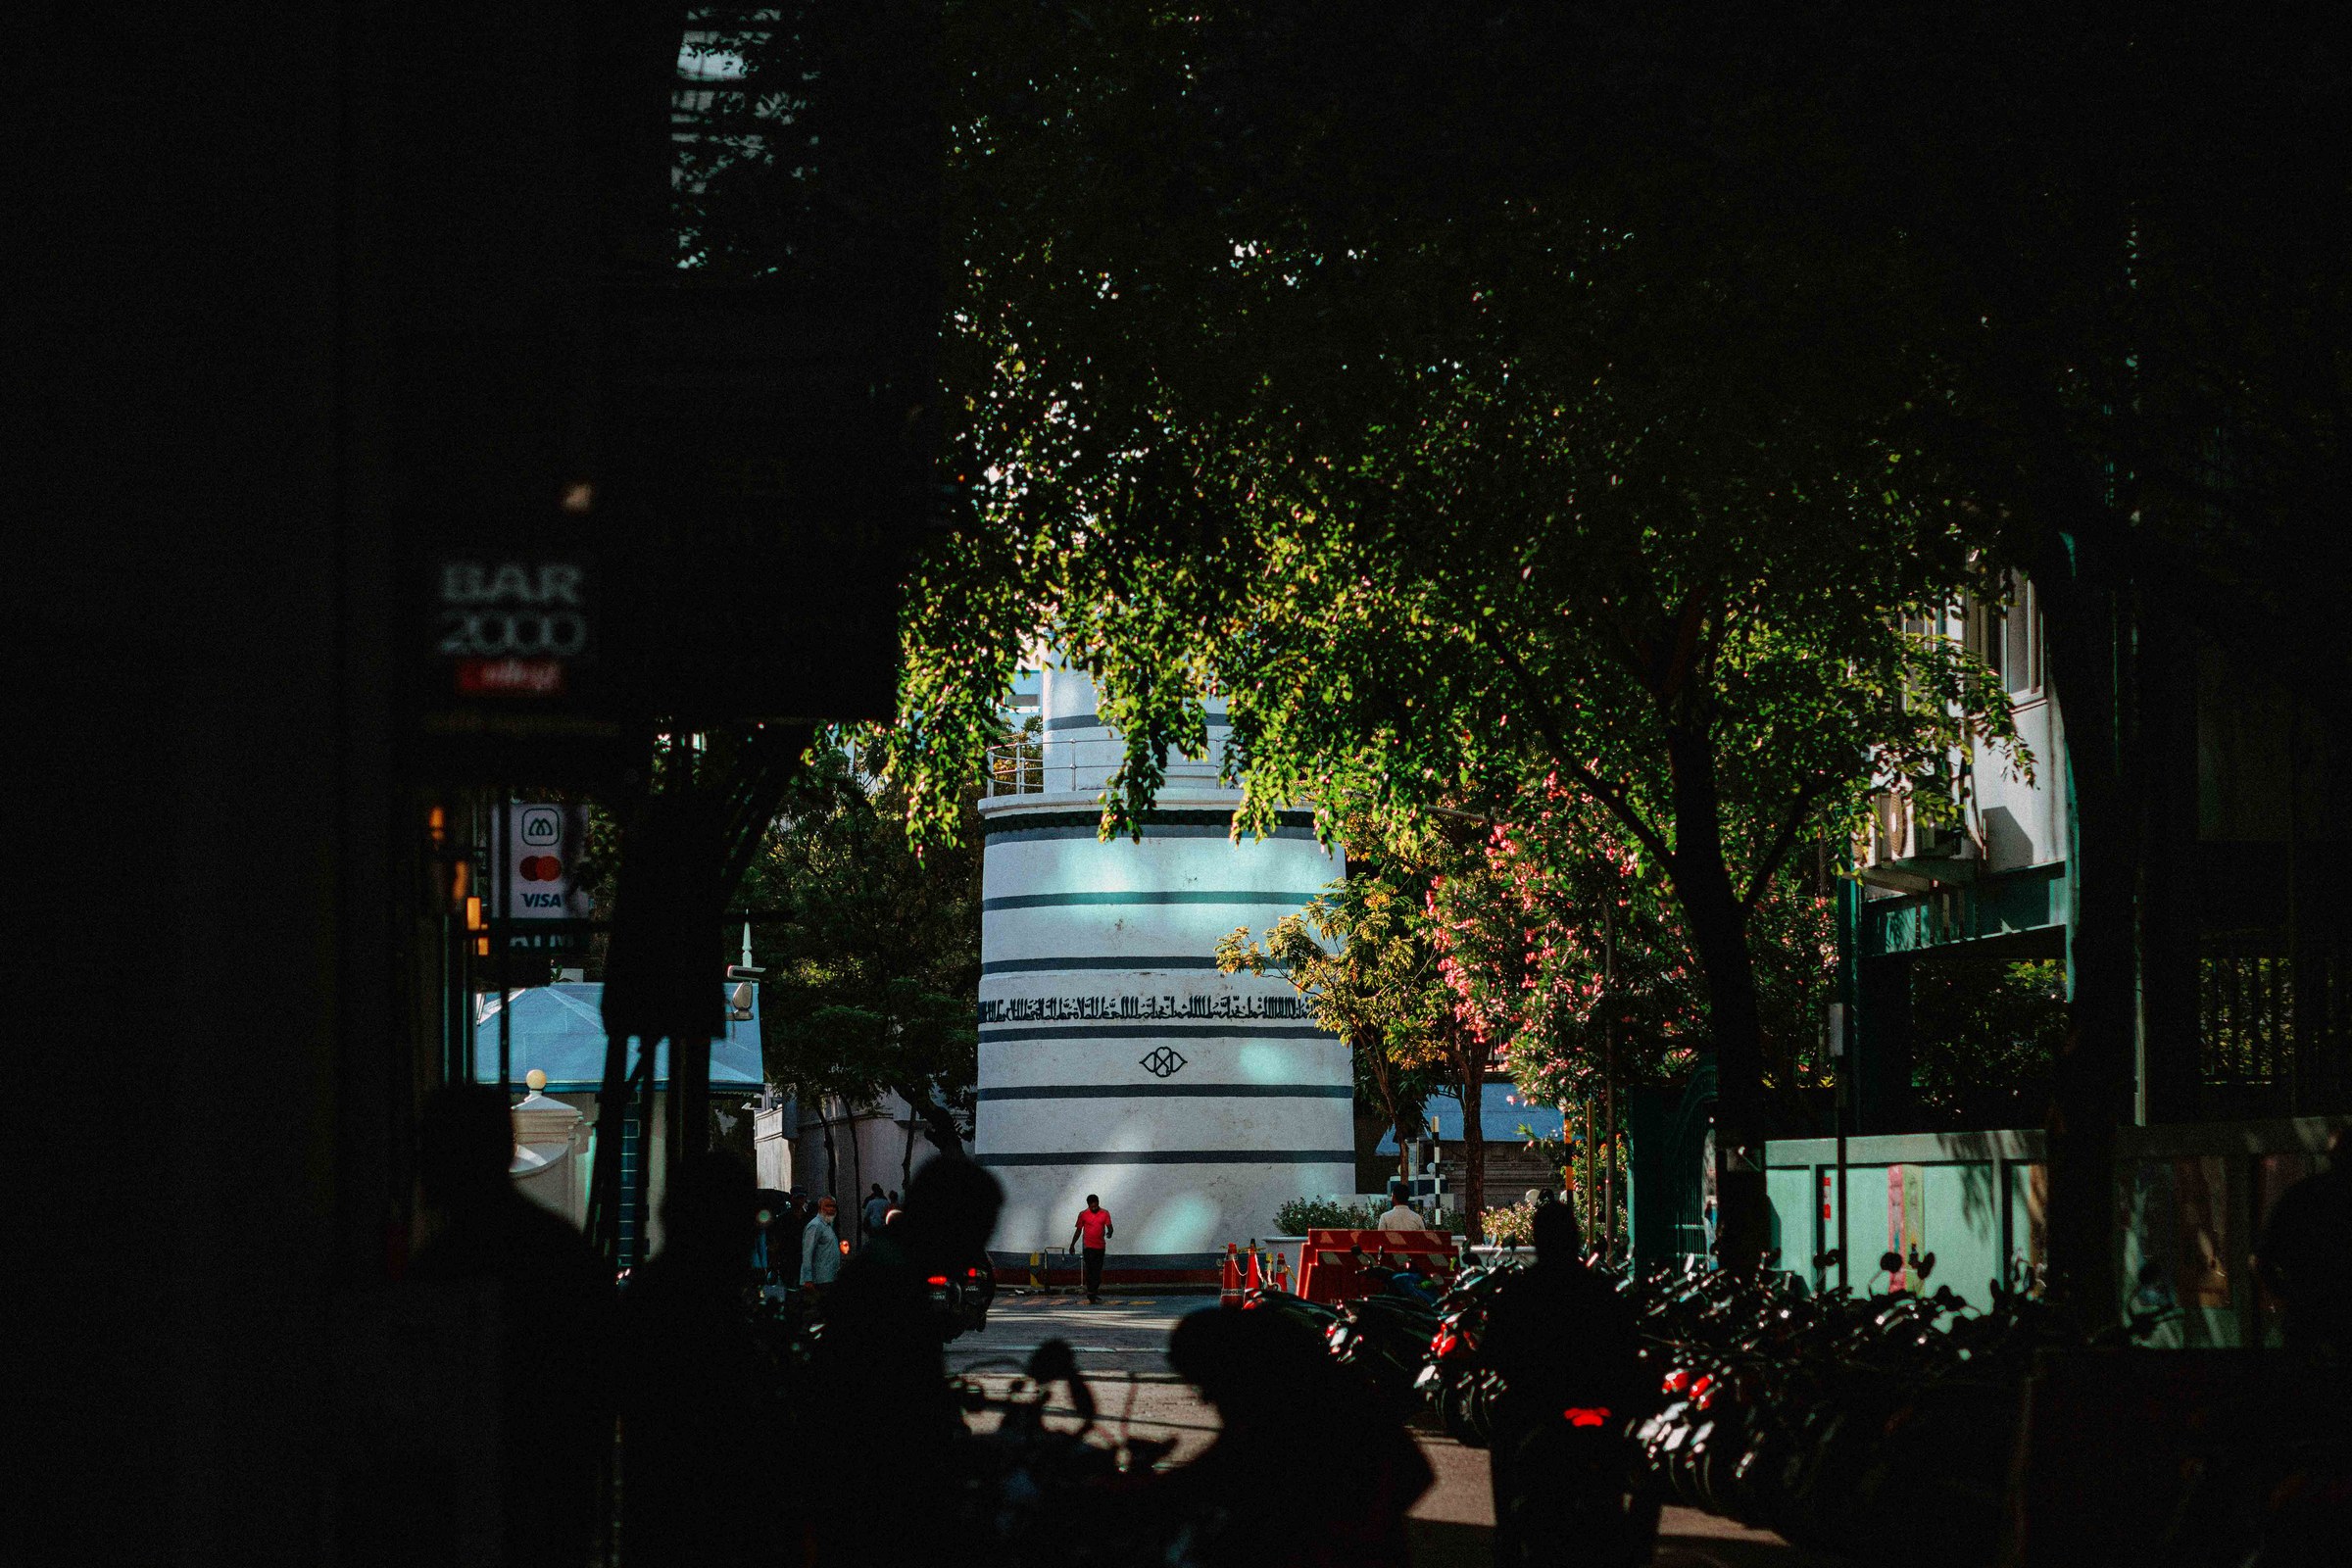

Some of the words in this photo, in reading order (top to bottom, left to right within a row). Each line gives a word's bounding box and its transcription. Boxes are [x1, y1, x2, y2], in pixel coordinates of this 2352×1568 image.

[441, 564, 583, 604] BAR
[439, 610, 588, 656] 2000
[520, 893, 562, 907] VISA
